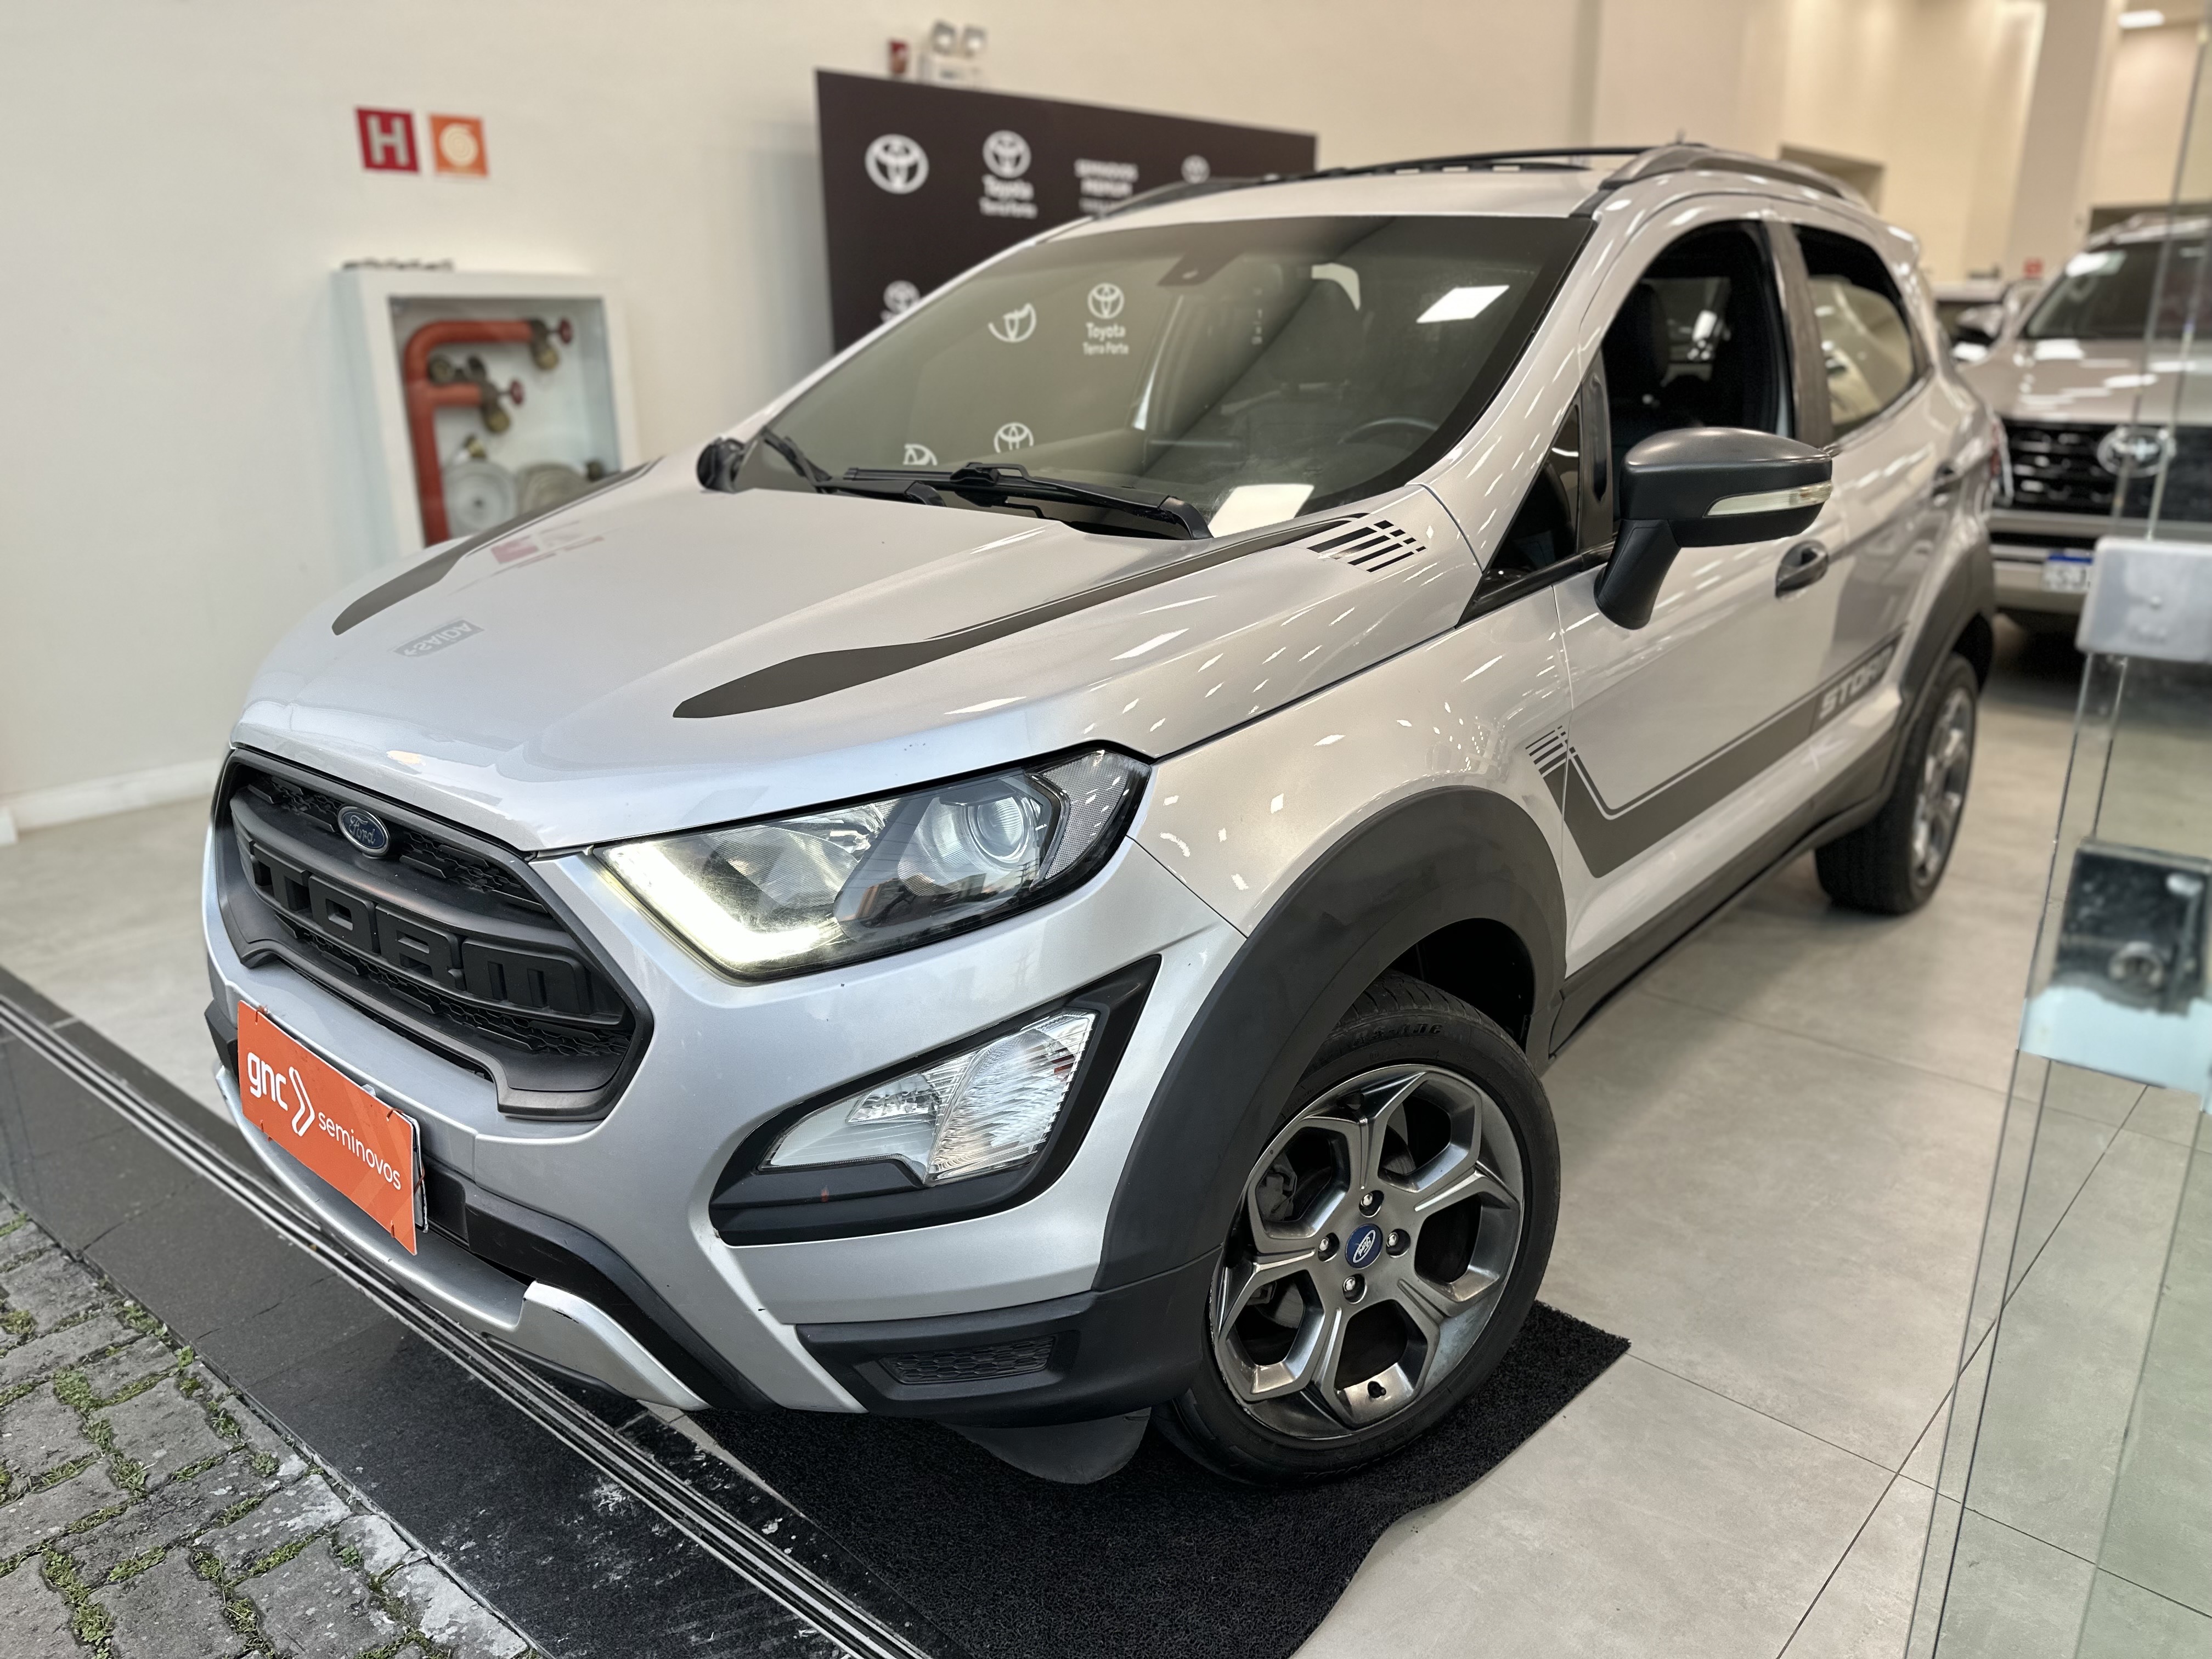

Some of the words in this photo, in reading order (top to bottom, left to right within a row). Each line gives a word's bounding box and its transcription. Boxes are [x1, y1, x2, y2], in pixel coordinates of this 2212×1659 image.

[366, 114, 410, 166] H
[1086, 322, 1126, 341] Toyota
[348, 814, 376, 845] Ford
[247, 1052, 288, 1111] gnc
[318, 1111, 402, 1190] seminovos
[1357, 1236, 1372, 1257] Ford
